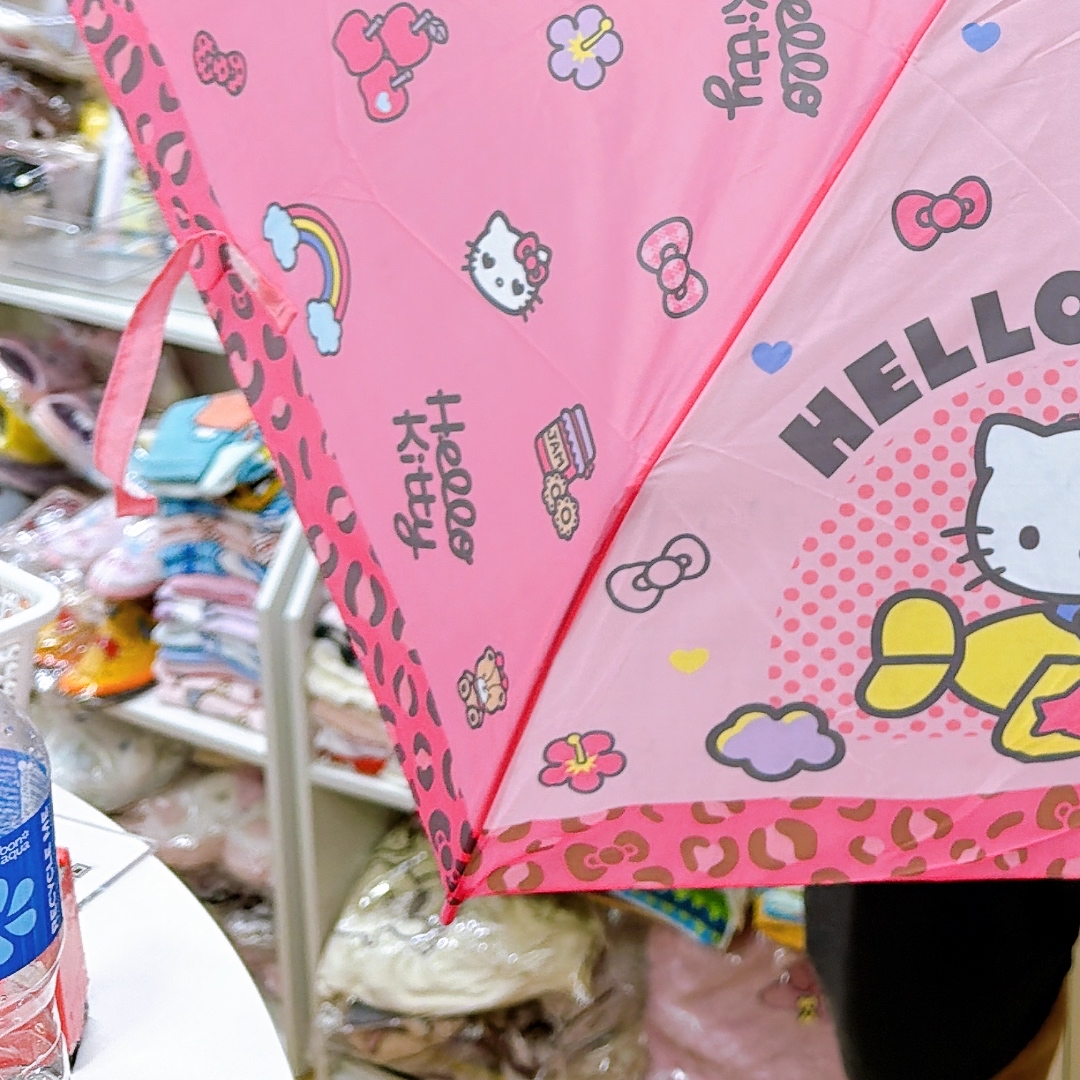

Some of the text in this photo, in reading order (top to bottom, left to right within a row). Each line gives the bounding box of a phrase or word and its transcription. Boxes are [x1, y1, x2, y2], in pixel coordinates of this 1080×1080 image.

[392, 409, 438, 561] Kitty
[425, 389, 476, 566] Hello
[547, 429, 565, 468] JAM
[0, 843, 31, 865] aqua
